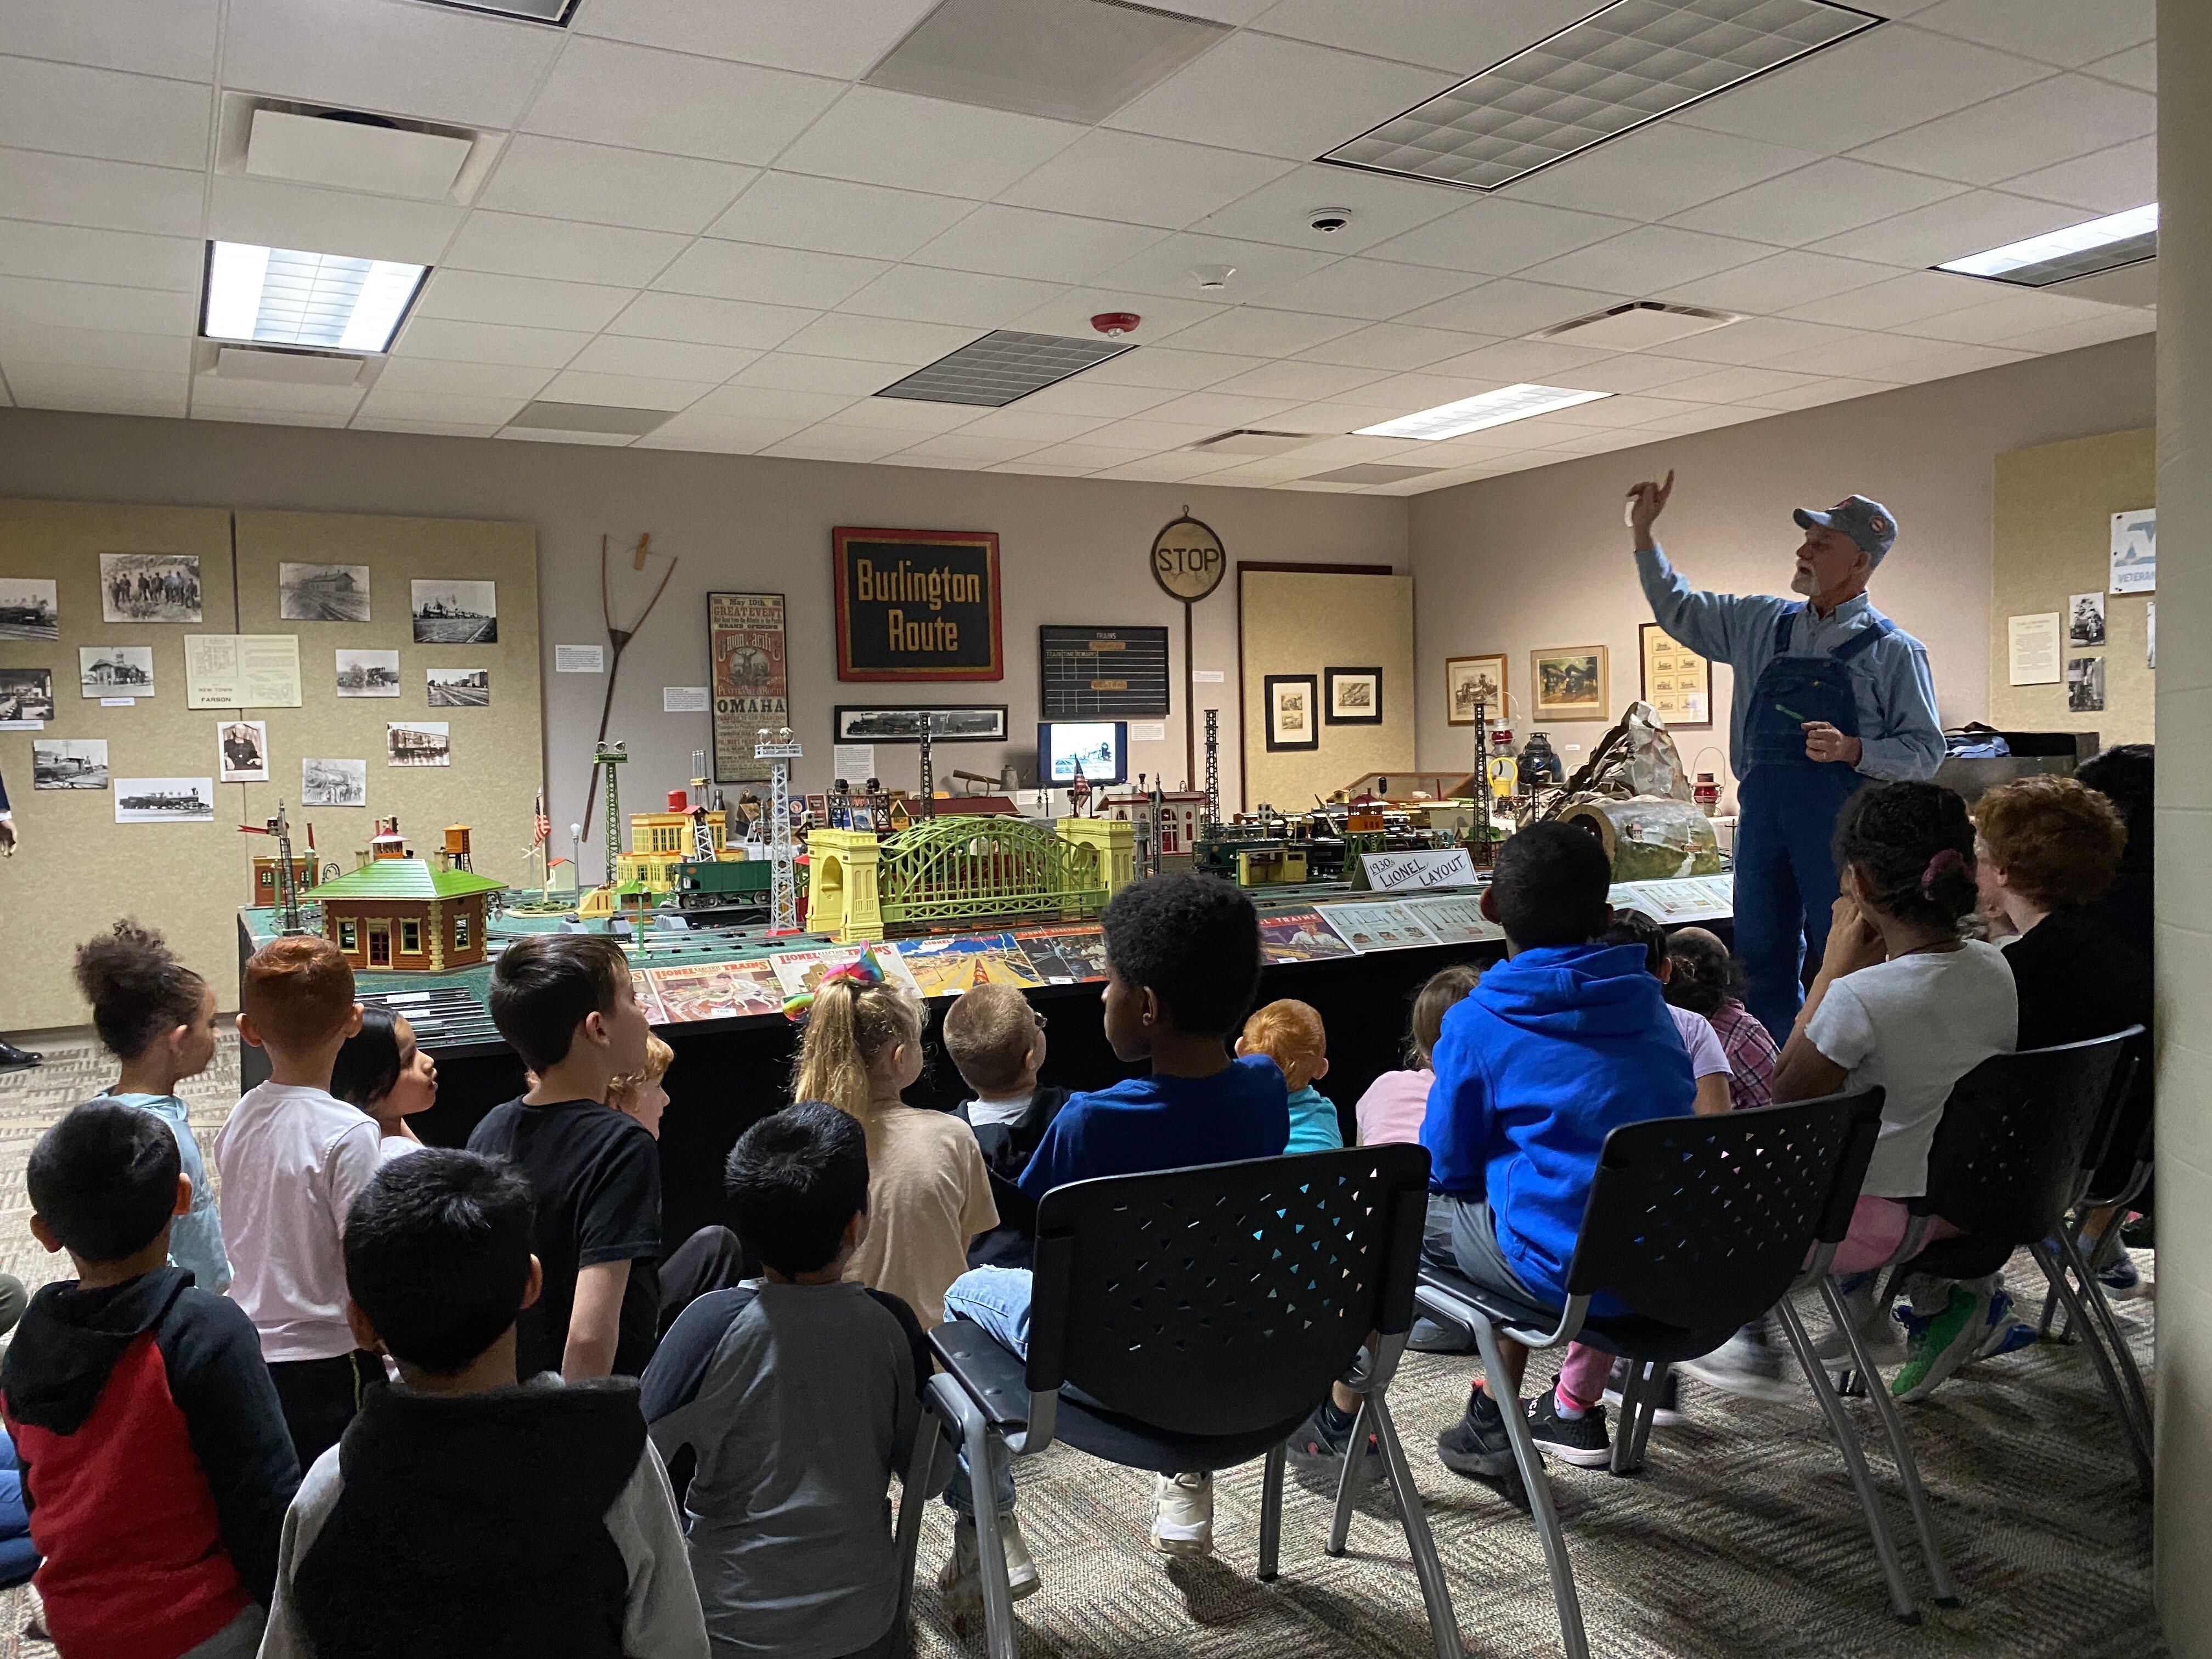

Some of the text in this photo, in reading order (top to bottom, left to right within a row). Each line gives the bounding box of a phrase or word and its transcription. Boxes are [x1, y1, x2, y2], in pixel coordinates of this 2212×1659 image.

[1158, 548, 1220, 572] STOP
[857, 558, 980, 611] Burlington
[714, 606, 782, 618] GREAT EVENT
[889, 610, 958, 652] Route
[717, 699, 786, 713] OMAHA
[1369, 857, 1395, 874] 1930s
[1379, 859, 1426, 888] LIONEL
[1419, 854, 1464, 887] LAYOUT
[1276, 914, 1317, 923] TRAINS
[778, 952, 820, 964] LIONEL
[845, 945, 891, 956] TRNS
[655, 968, 694, 980] LIONEL
[722, 961, 768, 970] TRAINS
